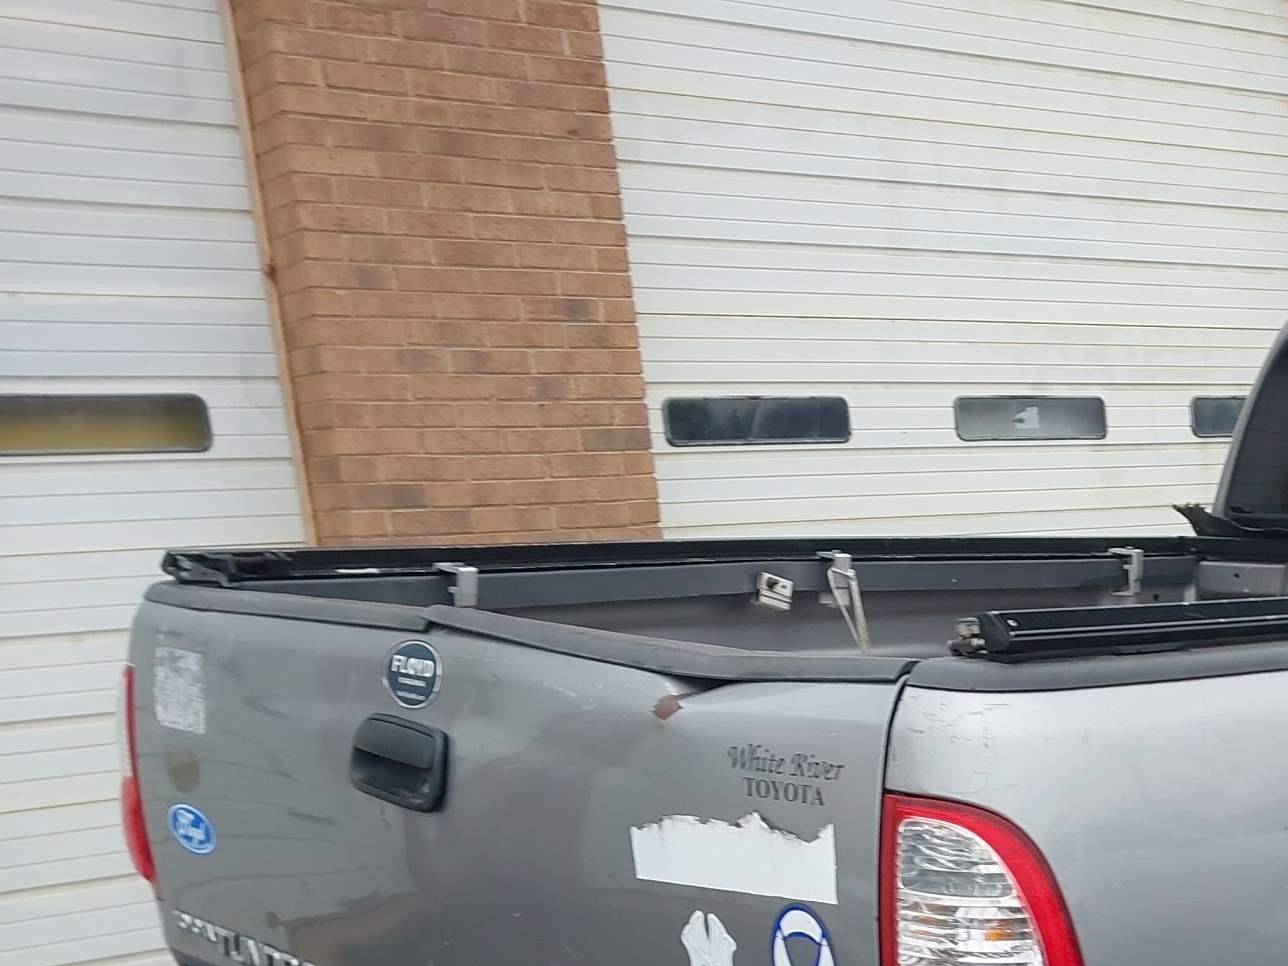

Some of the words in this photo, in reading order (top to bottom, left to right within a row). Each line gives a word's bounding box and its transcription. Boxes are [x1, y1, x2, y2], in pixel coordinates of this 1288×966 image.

[727, 743, 786, 775] White
[789, 752, 846, 782] River
[743, 776, 825, 806] TOYOTA
